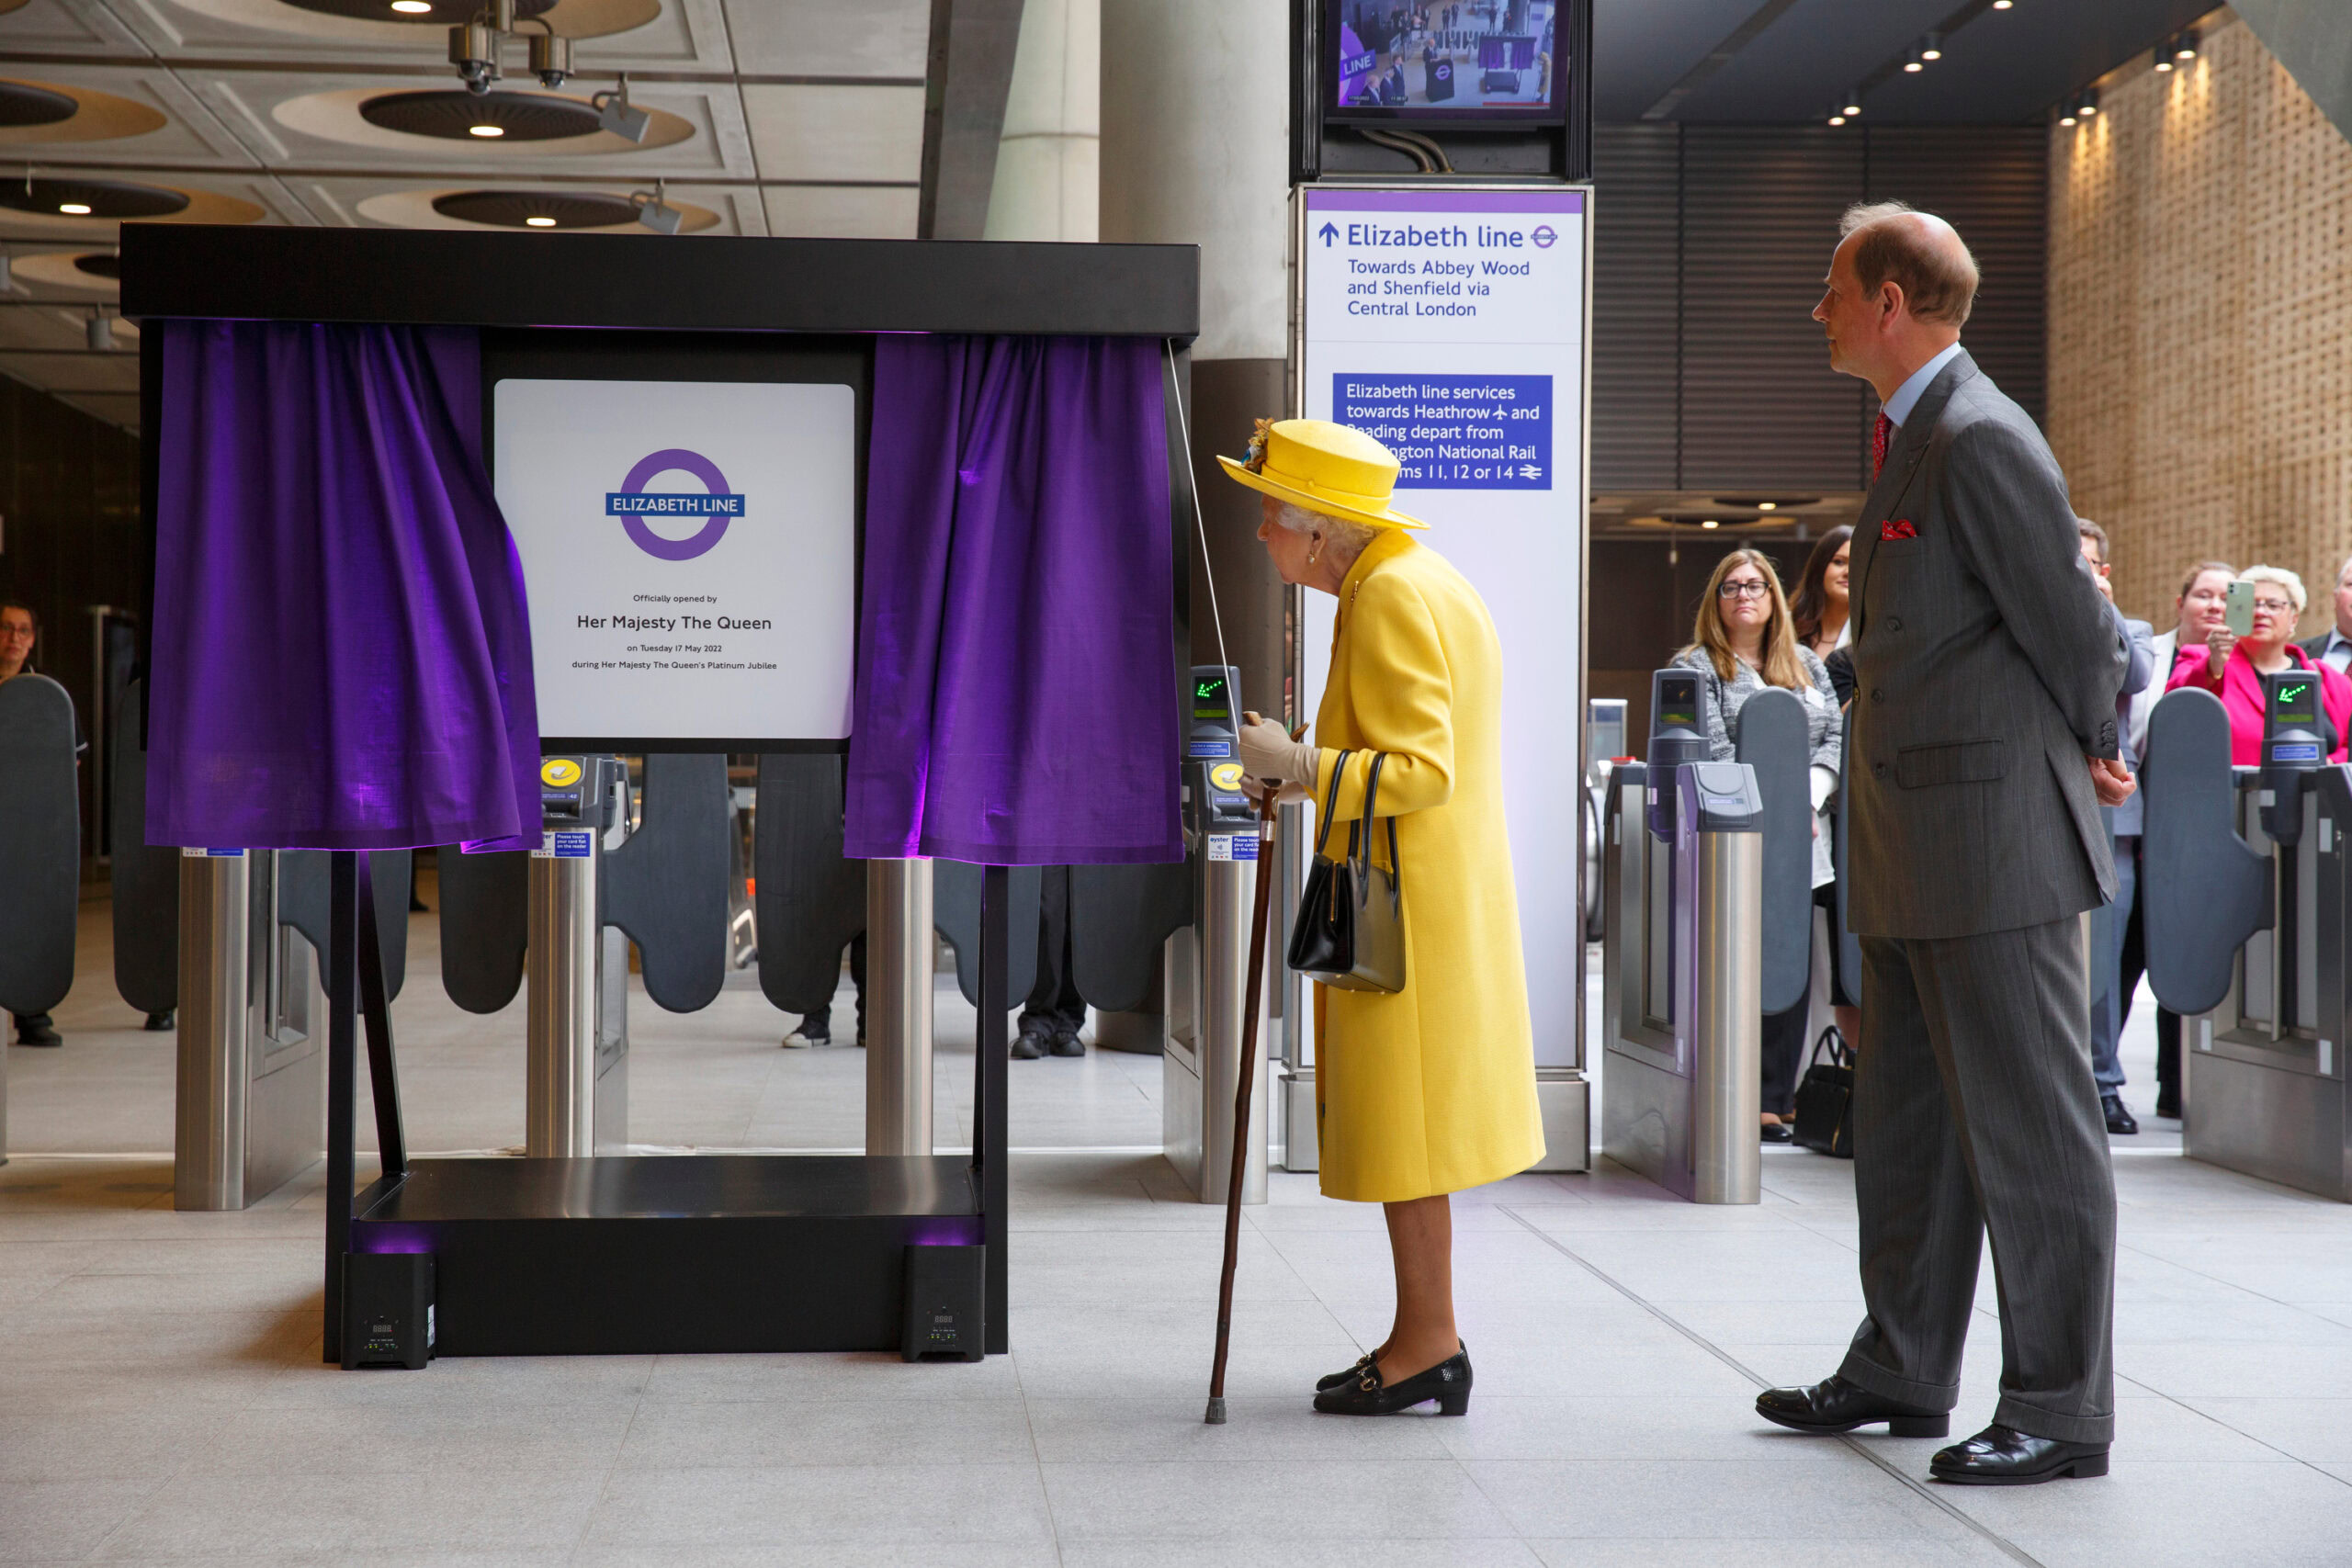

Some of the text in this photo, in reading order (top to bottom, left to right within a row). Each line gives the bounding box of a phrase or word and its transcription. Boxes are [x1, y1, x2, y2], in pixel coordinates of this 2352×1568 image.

[1343, 55, 1372, 75] LINE
[1348, 223, 1523, 248] Elizabeth line
[1347, 259, 1530, 279] Towards Abbey Wood
[1347, 280, 1490, 296] and Shenfield via
[1347, 300, 1476, 317] Central London
[1346, 383, 1516, 400] Elizabeth line services
[1346, 403, 1540, 420] towards Heathrow and
[1410, 424, 1462, 443] depart
[1465, 424, 1504, 440] from
[1438, 444, 1505, 460] National
[1509, 446, 1537, 460] Rail
[1429, 465, 1448, 480] 11,
[1453, 465, 1470, 479] 12
[1474, 468, 1492, 479] or
[1497, 465, 1514, 479] 14
[613, 498, 739, 513] ELIZABETH LINE
[632, 594, 718, 604] Officially opened by
[577, 615, 772, 632] Her Majesty The Queen
[639, 644, 673, 653] Tuesday
[684, 645, 702, 654] May
[703, 645, 722, 653] 2022
[571, 660, 600, 671] during
[601, 660, 617, 669] Her
[618, 660, 651, 671] Majesty
[671, 661, 706, 670] Queen's
[707, 661, 745, 670] Platinum
[747, 661, 777, 670] Jubilee
